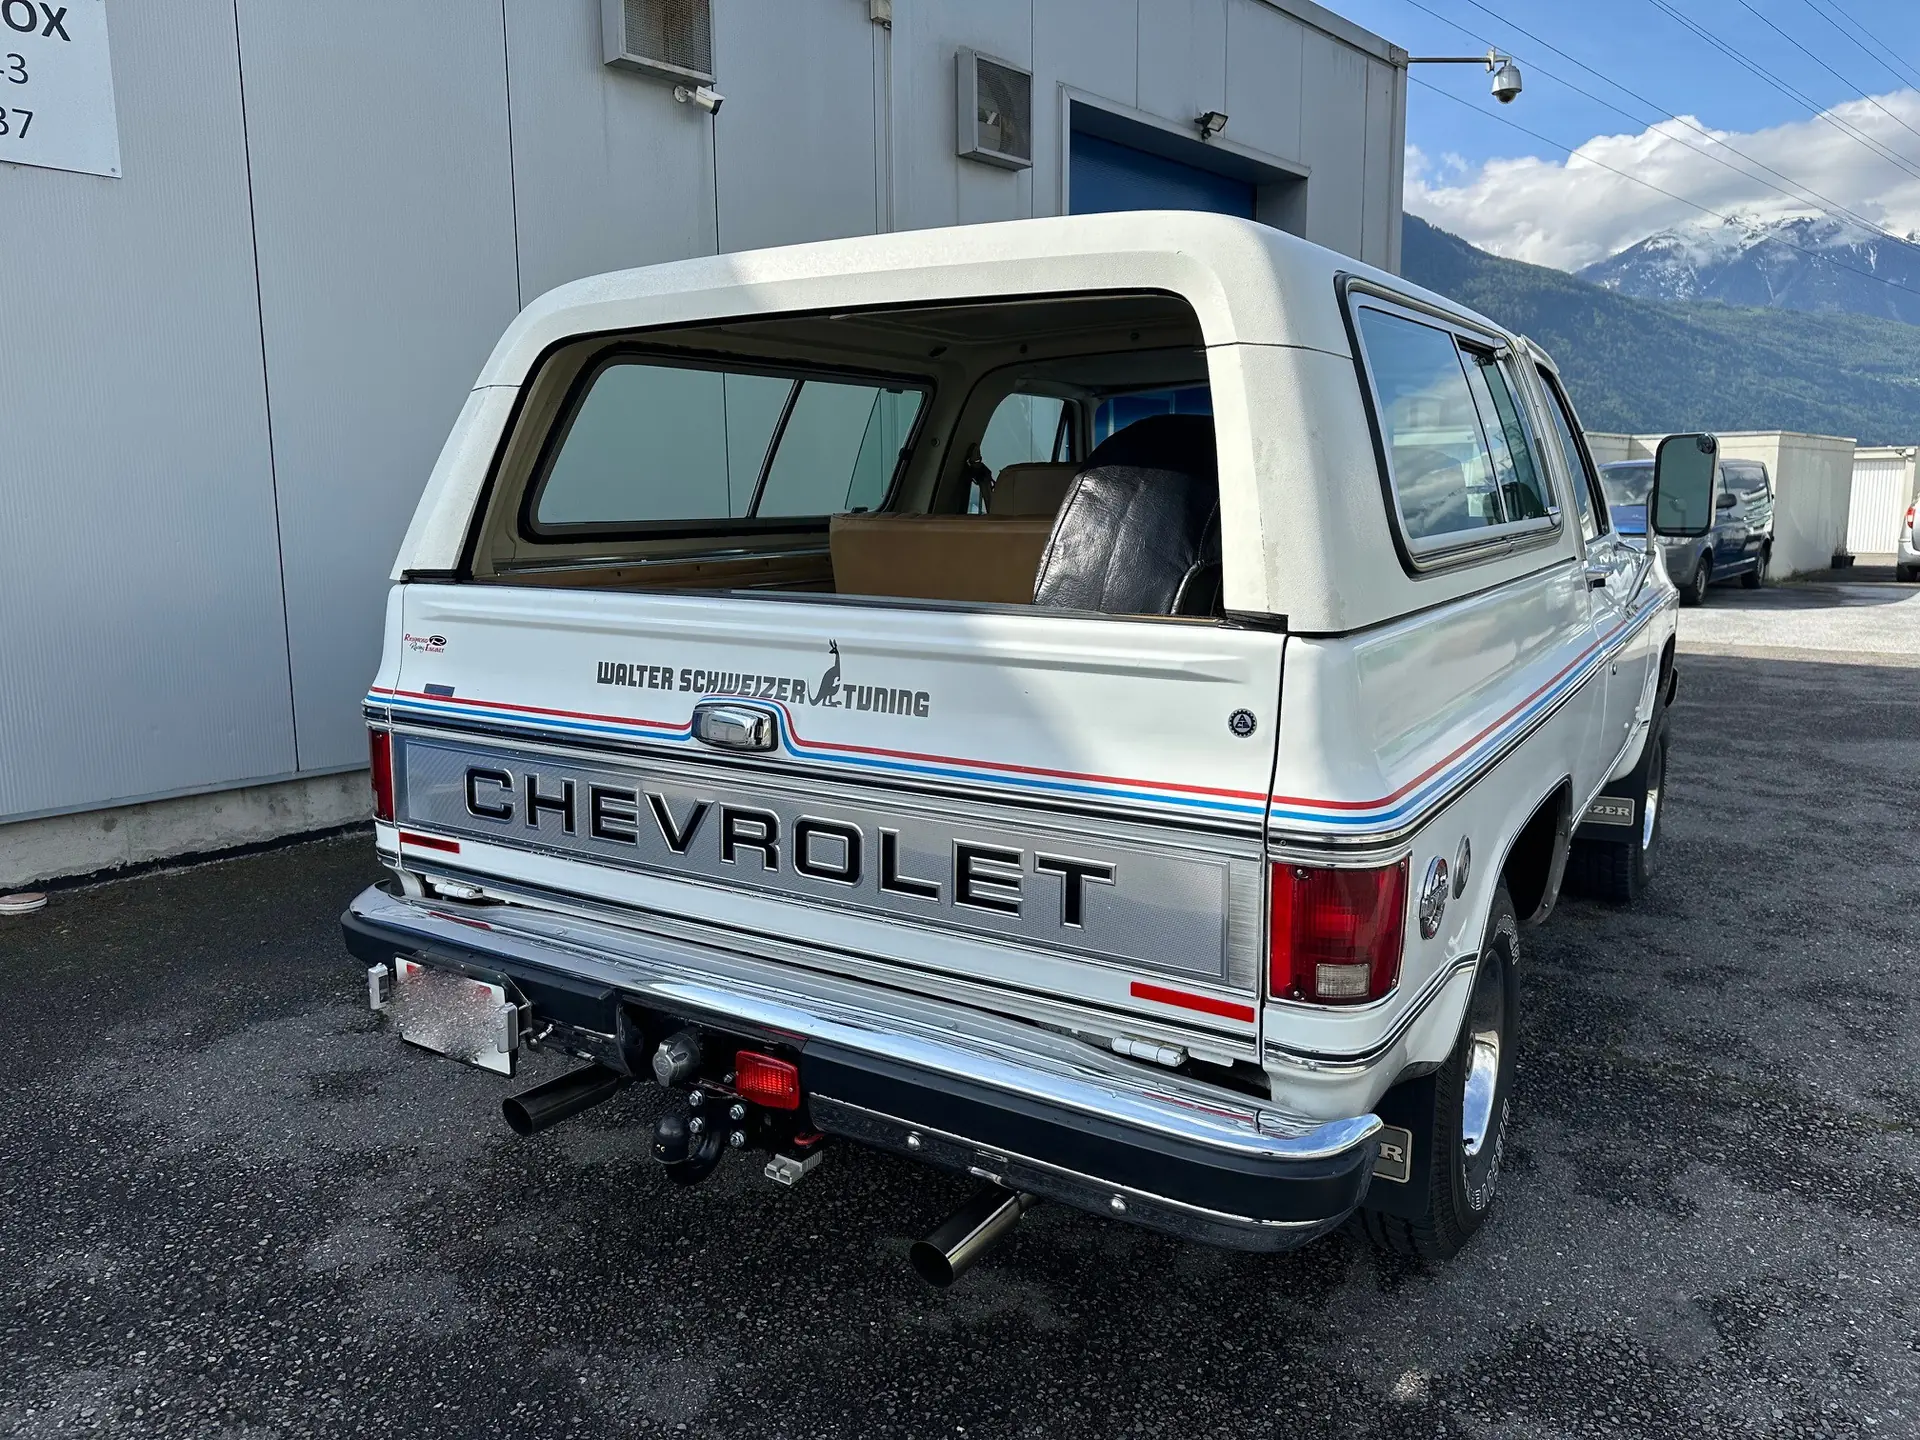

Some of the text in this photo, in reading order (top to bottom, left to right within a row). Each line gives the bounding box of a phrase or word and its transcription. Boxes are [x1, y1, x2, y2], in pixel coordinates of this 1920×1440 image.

[597, 661, 931, 718] WALTER SCHWEIZER TUNING
[1588, 804, 1631, 817] ZER
[463, 764, 1118, 930] CHEVROLET
